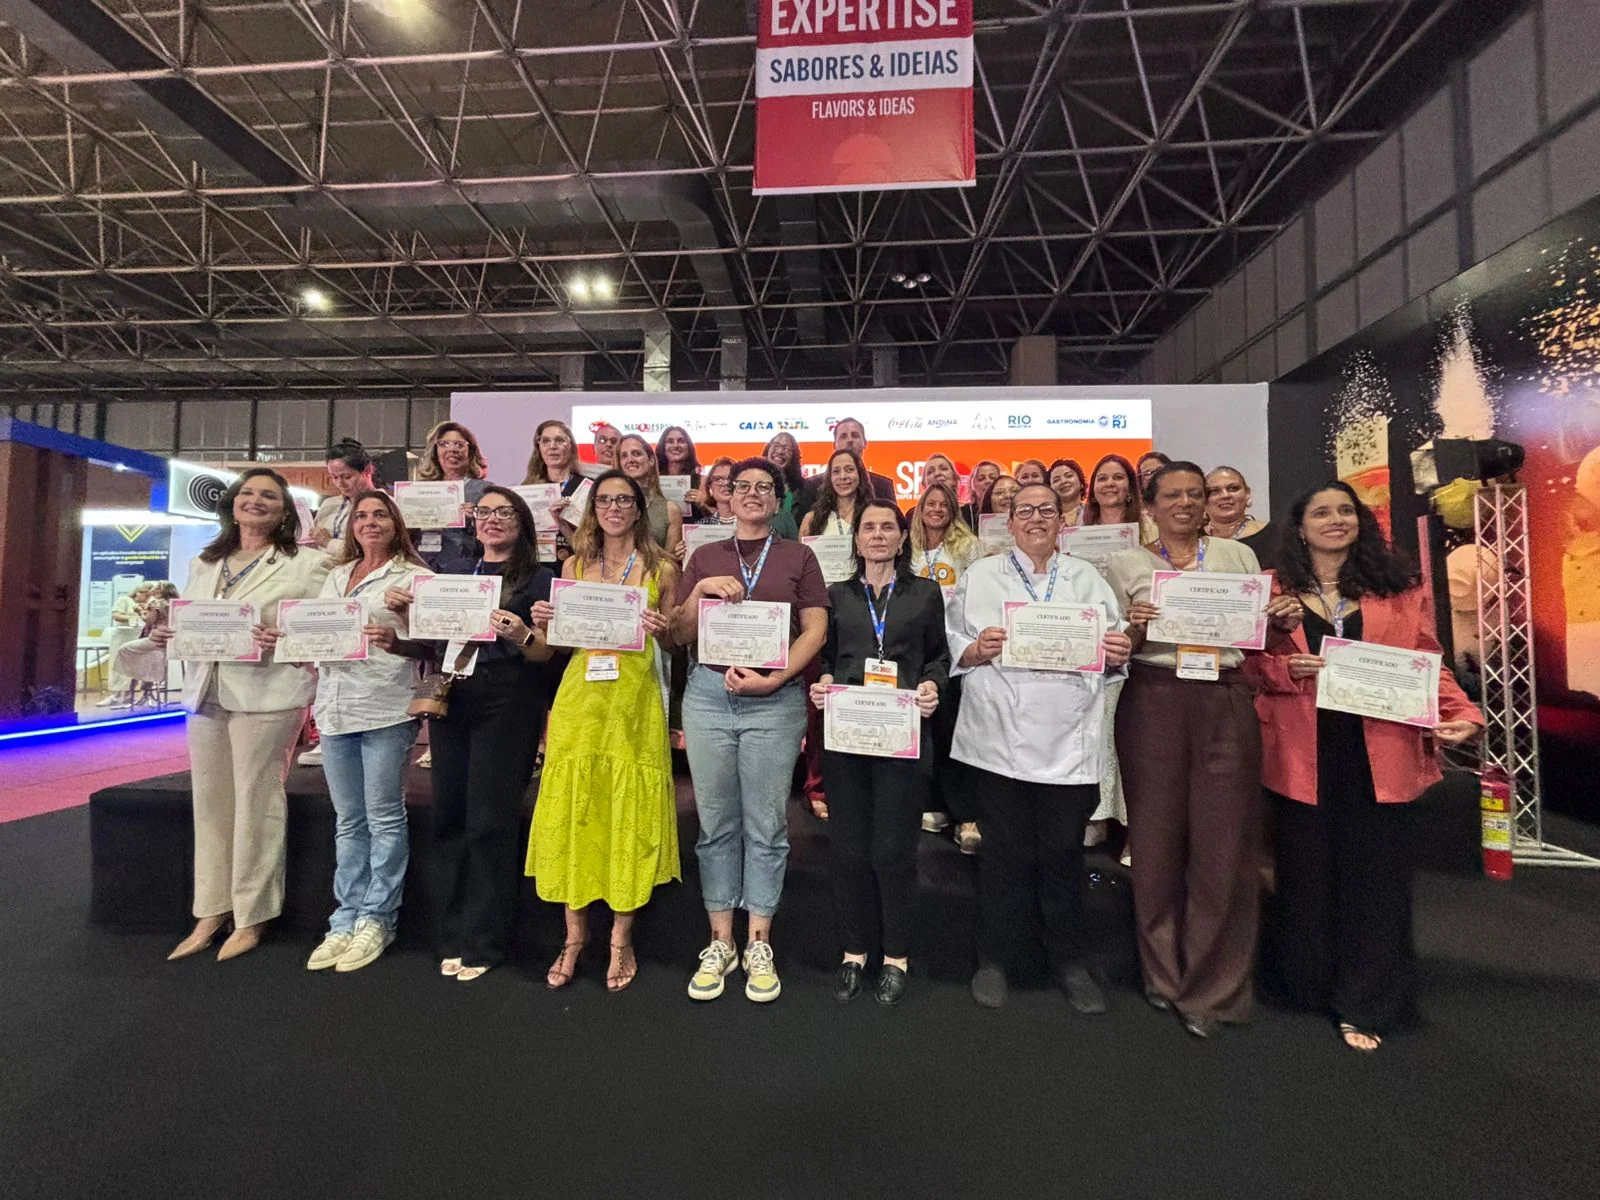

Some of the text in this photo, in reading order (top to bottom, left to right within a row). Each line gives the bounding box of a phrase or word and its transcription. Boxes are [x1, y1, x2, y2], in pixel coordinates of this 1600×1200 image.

[771, 0, 958, 36] EXPERTISE
[770, 50, 959, 83] SABORES & IDEIAS
[812, 97, 915, 119] FLAVORS & IDEAS
[1008, 415, 1031, 425] RIO
[1112, 420, 1127, 429] RJ
[739, 422, 773, 430] CAIXA
[1359, 657, 1398, 668] CERTIFICADO
